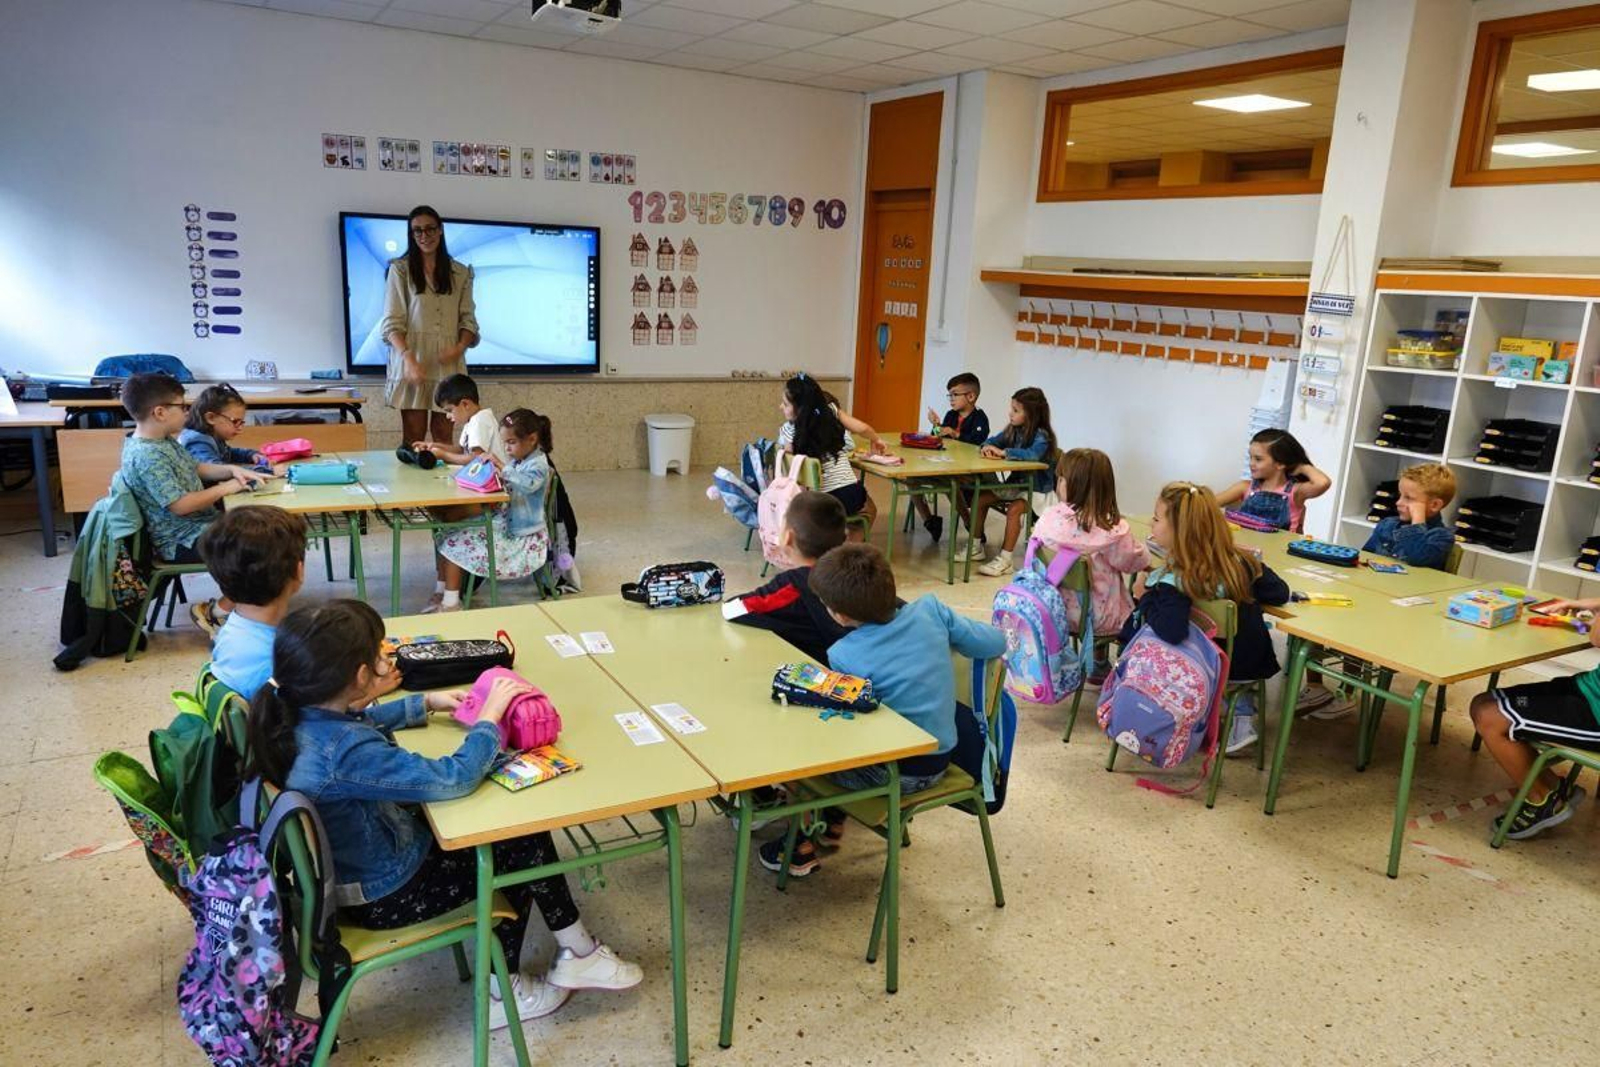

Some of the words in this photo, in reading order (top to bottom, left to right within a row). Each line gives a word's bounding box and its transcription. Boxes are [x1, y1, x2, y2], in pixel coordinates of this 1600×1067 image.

[627, 190, 643, 223] 1
[645, 191, 667, 224] 2
[668, 191, 687, 223] 3
[689, 192, 707, 225] 4
[709, 192, 727, 225] 5
[728, 193, 748, 225] 6
[748, 195, 767, 226] 7
[768, 195, 787, 226] 8
[787, 197, 805, 228] 9
[813, 198, 847, 229] 10
[211, 898, 235, 918] GIRL
